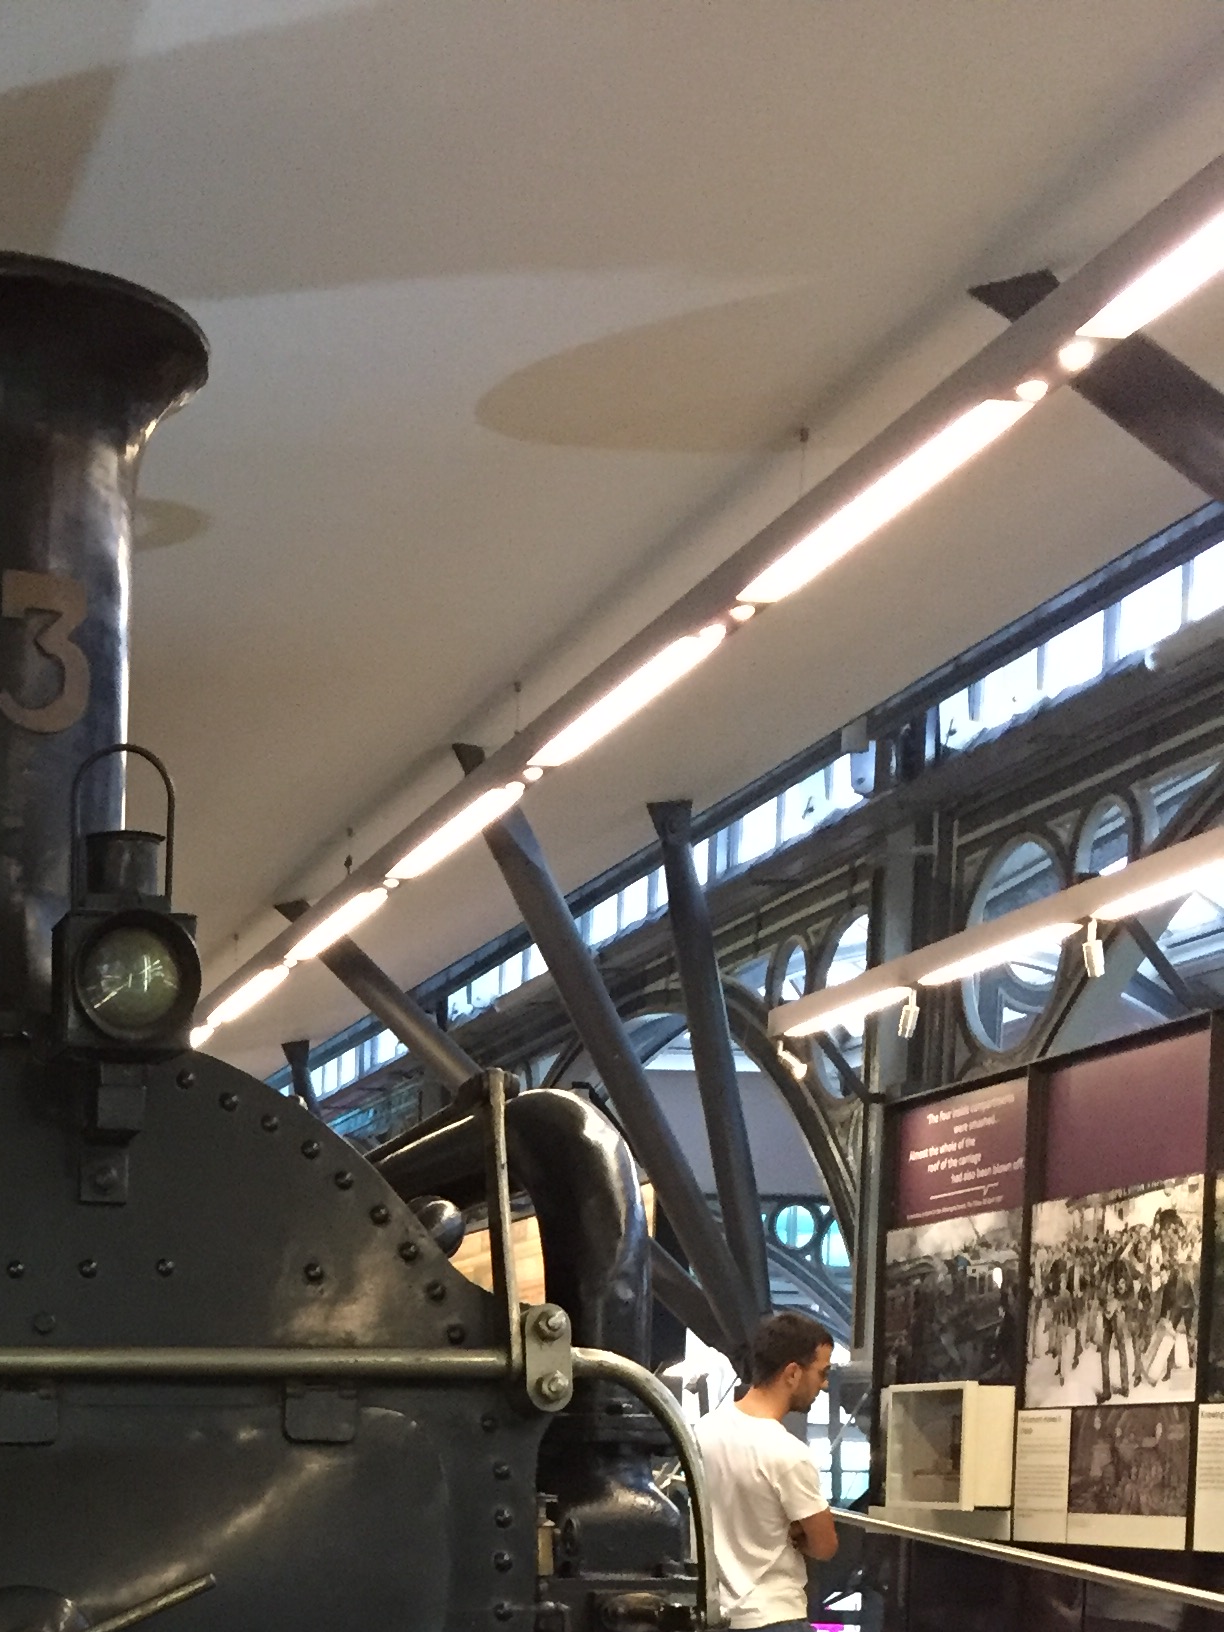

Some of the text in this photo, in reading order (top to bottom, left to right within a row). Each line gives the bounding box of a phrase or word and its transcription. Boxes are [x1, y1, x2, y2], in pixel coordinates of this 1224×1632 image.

[909, 1148, 929, 1161] Almost
[929, 1145, 939, 1157] the
[939, 1142, 957, 1154] whole
